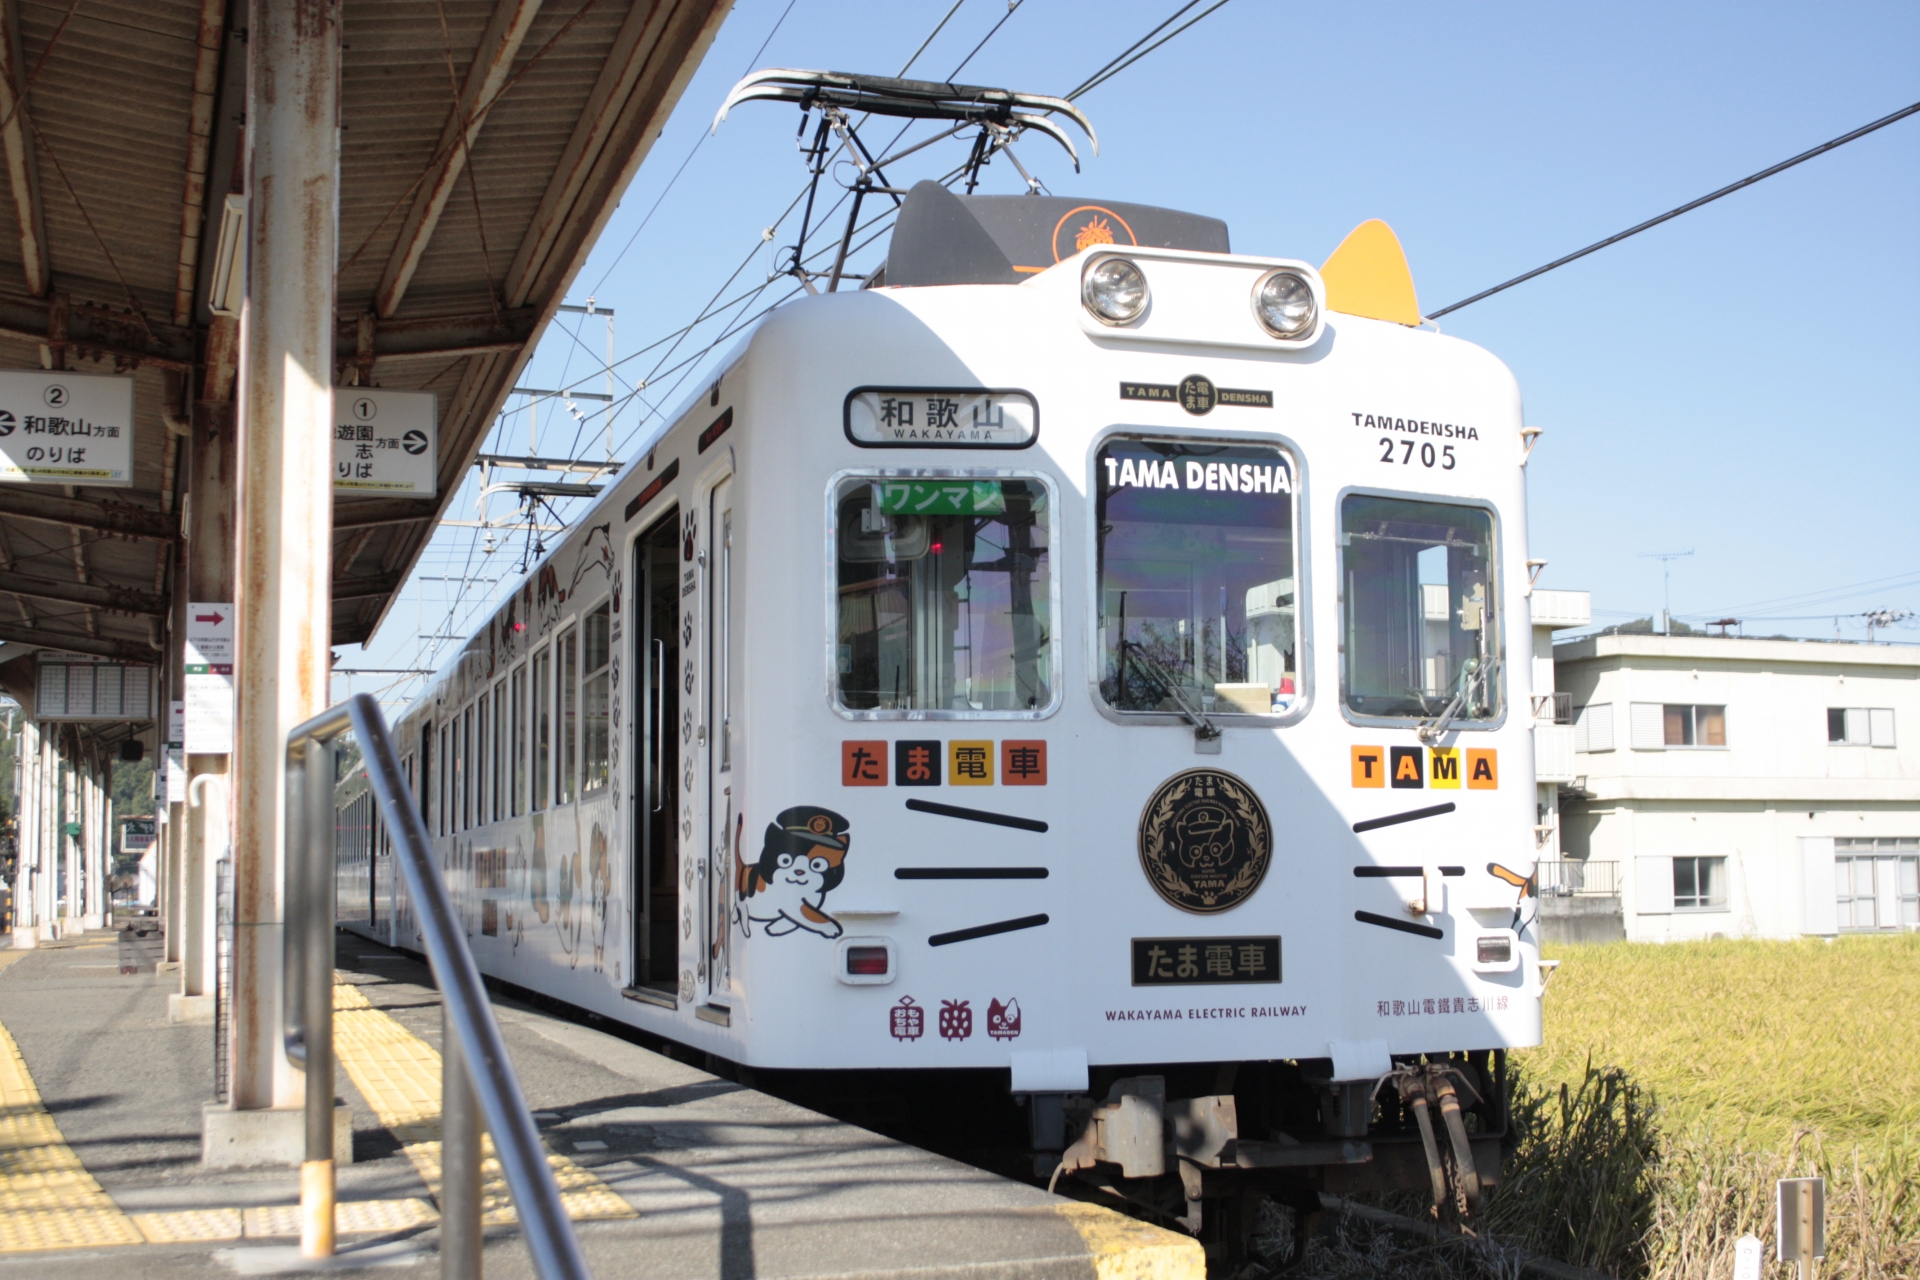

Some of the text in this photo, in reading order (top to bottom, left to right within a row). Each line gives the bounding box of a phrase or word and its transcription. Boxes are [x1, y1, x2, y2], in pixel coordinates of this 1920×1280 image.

[1126, 386, 1171, 399] TAMA
[1221, 392, 1269, 404] DENSHA
[880, 397, 1004, 429] 和歌山
[334, 425, 374, 441] 遊園
[894, 428, 993, 441] WAKAYAMA
[1351, 412, 1480, 441] TAMADENSHA
[375, 437, 400, 450] 方面
[1378, 437, 1457, 470] 2705
[26, 446, 87, 464] のりば
[1104, 457, 1292, 494] TAMA DENSHA
[884, 483, 1000, 512] ワンマン
[851, 746, 1041, 780] たま電車
[1358, 754, 1493, 781] TAMA
[1193, 879, 1225, 889] TAMA
[1147, 944, 1267, 978] たま電車
[1105, 1005, 1308, 1022] WAKAYAMA ELECTRIC RAILWAY
[1377, 995, 1509, 1017] 和歌山電鐵貴志川線
